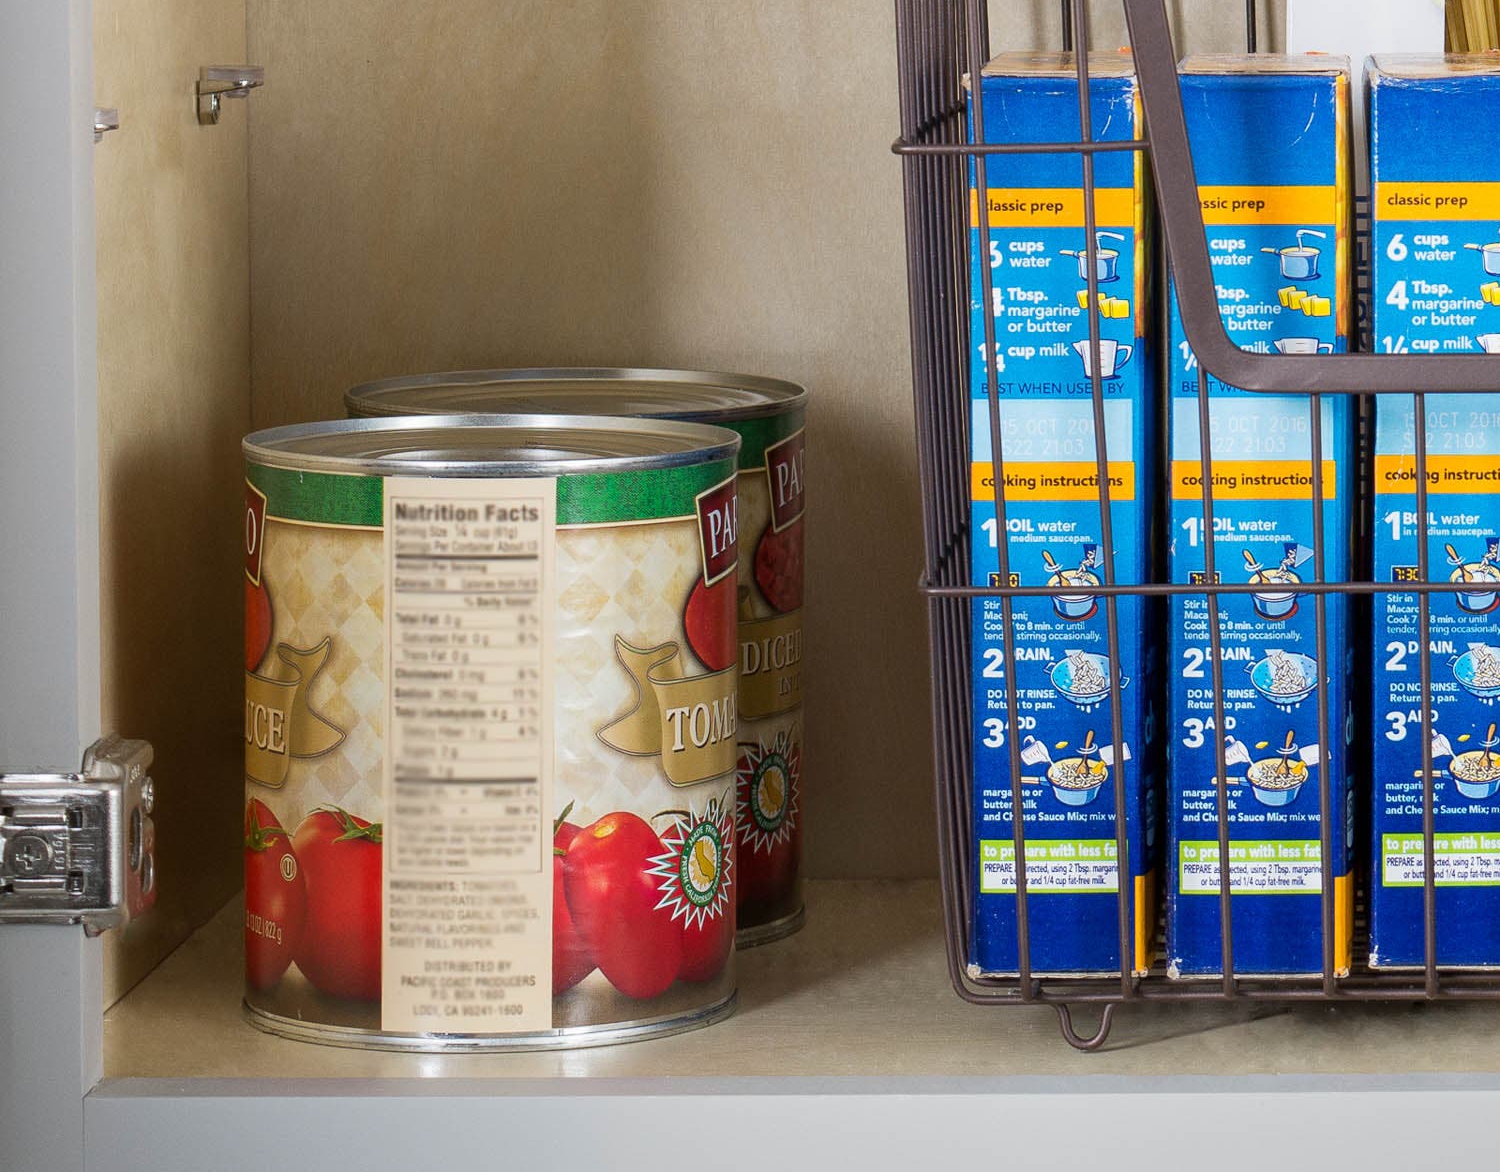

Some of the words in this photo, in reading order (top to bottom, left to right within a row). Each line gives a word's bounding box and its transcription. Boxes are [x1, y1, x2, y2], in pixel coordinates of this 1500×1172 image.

[1232, 198, 1265, 212] prep
[1387, 193, 1431, 206] classic
[1435, 195, 1468, 209] prep
[1031, 201, 1063, 215] prep
[1009, 241, 1045, 254] cups
[1210, 238, 1246, 252] cups
[1386, 234, 1408, 261] 6
[1413, 235, 1449, 248] cups
[1009, 256, 1051, 267] water
[1211, 254, 1253, 266] water
[1414, 249, 1456, 261] water
[1385, 280, 1409, 310] 4
[1411, 281, 1452, 297] Tbsp.
[1007, 288, 1048, 304] Tbsp.
[1411, 298, 1485, 313] margarine
[1007, 305, 1080, 320] margarine
[1411, 316, 1427, 326] or
[1431, 312, 1476, 326] butter
[1007, 322, 1023, 332] or
[1027, 319, 1072, 332] butter
[1228, 317, 1274, 330] butter
[1412, 338, 1439, 352] cup
[1443, 335, 1473, 350] milk
[1007, 345, 1035, 359] cup
[1039, 342, 1069, 356] milk
[1019, 383, 1062, 393] WHEN
[1108, 383, 1124, 393] BY
[395, 503, 478, 522] Nutrition
[485, 504, 539, 522] Facts
[1238, 519, 1277, 531] water
[1385, 511, 1400, 541] 1
[1441, 514, 1480, 525] water
[1249, 533, 1294, 543] saucepan.
[1403, 527, 1412, 536] in
[1451, 528, 1496, 538] saucepan.
[1387, 594, 1402, 603] Stir
[1404, 594, 1413, 603] in
[1387, 615, 1411, 624] Cook
[1436, 615, 1456, 624] min.
[1468, 614, 1488, 623] until
[1387, 625, 1417, 635] tender,
[1385, 641, 1407, 671] 2
[1390, 683, 1407, 692] DO
[1430, 683, 1460, 692] RINSE.
[1390, 694, 1422, 703] Return
[1437, 695, 1458, 704] pan.
[1385, 711, 1407, 742] 3
[1385, 793, 1417, 804] butter,
[1385, 805, 1403, 815] and
[1440, 805, 1467, 815] Sauce
[1452, 836, 1479, 849] with
[1386, 858, 1415, 867] PREPARE
[1457, 870, 1468, 880] cup
